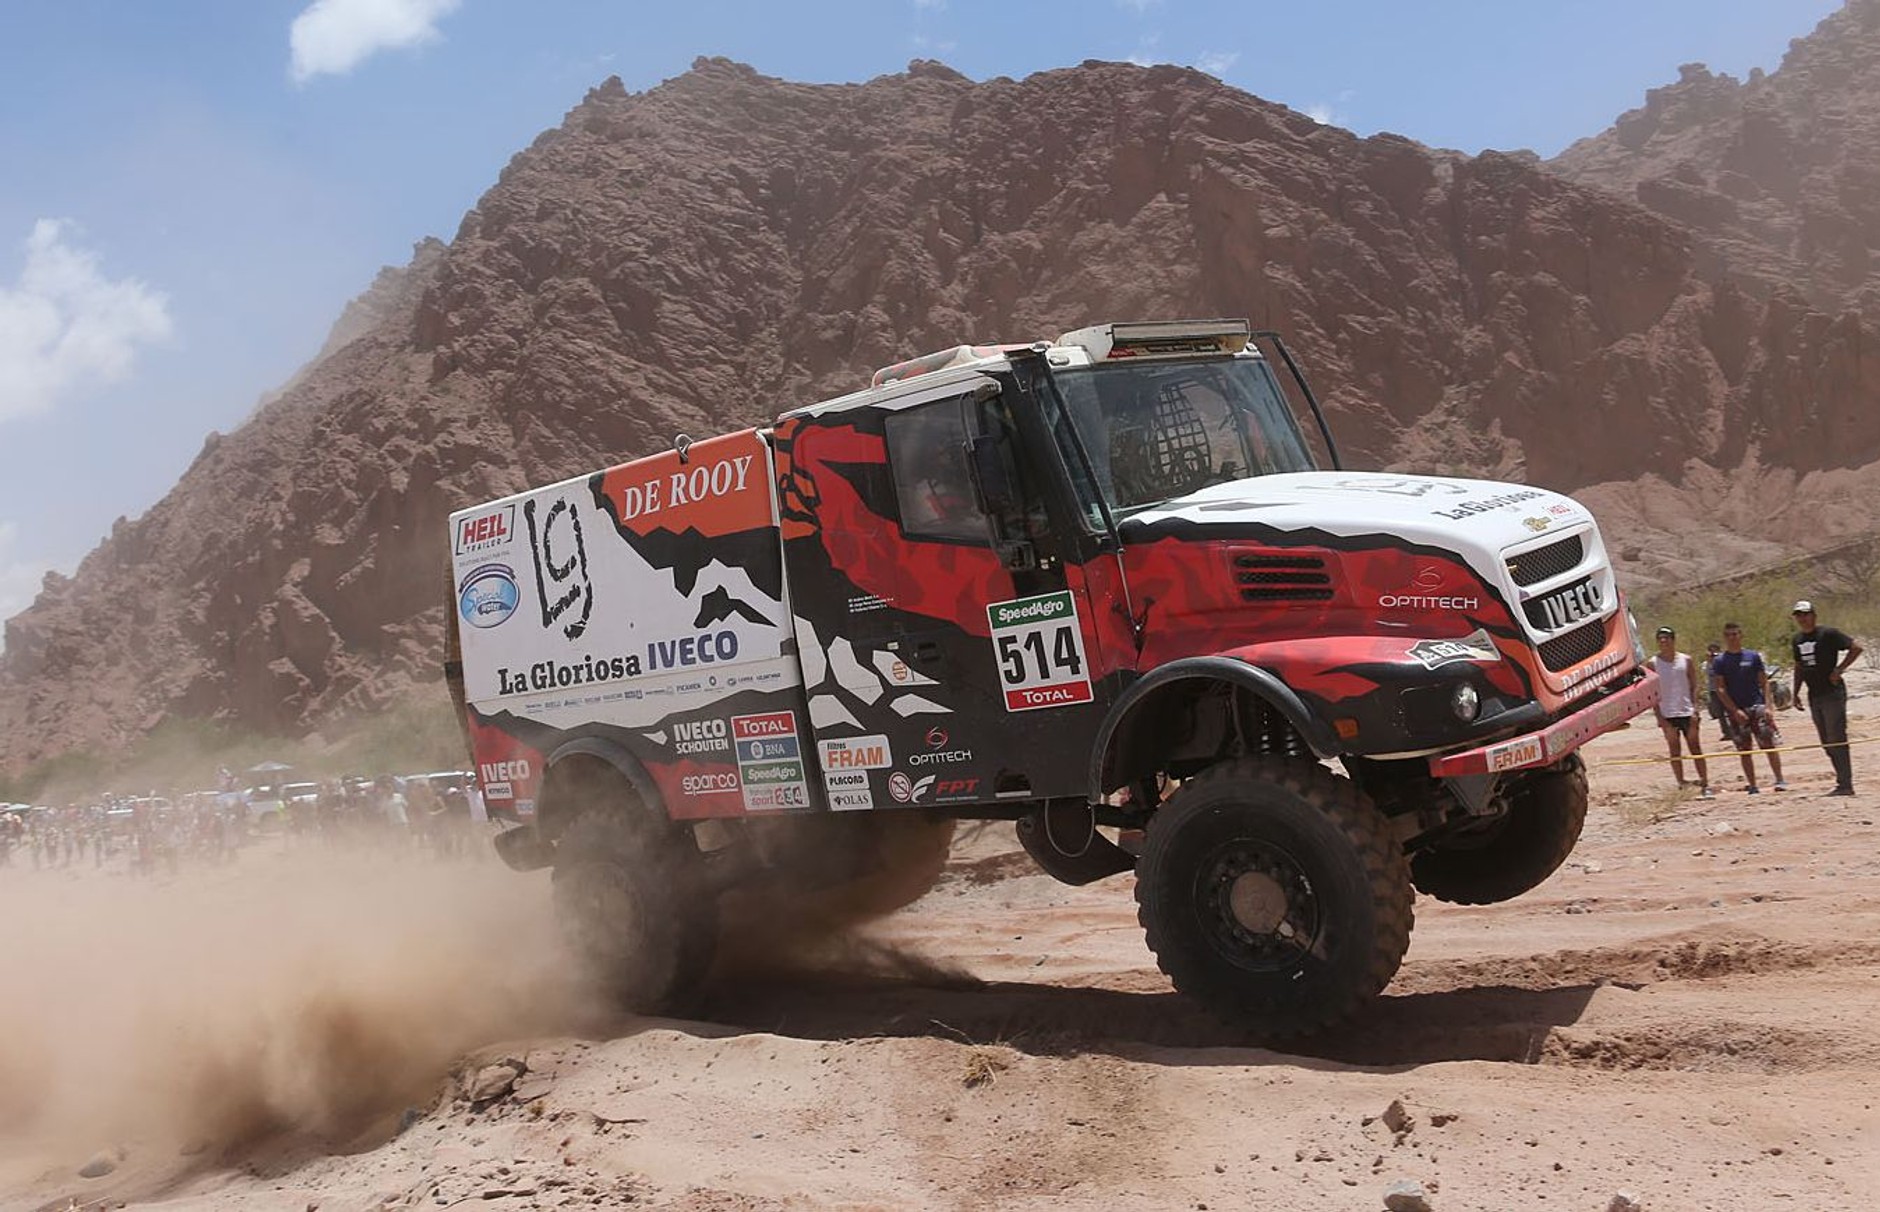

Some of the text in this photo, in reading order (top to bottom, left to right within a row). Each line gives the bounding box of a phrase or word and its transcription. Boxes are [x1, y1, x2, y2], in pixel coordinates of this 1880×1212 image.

[624, 455, 753, 521] DE ROOY
[463, 512, 507, 545] HEIL
[998, 601, 1064, 622] SpeedAgro
[1379, 595, 1478, 609] OPTITECH
[1542, 578, 1603, 629] IVECO
[648, 630, 738, 670] IVECO
[997, 626, 1081, 685] 514
[1022, 689, 1074, 704] TOTAL
[673, 719, 727, 741] IVECO
[739, 719, 789, 734] TOTAL
[676, 738, 730, 754] SCHOUTEN
[765, 744, 786, 755] BNA
[828, 747, 884, 768] FRAM
[909, 750, 972, 766] OPTITECH
[1493, 745, 1537, 769] FRAM
[480, 759, 530, 782] IVECO
[747, 767, 797, 782] SpeedAgro
[682, 773, 738, 796] sparco
[936, 779, 980, 795] FPT
